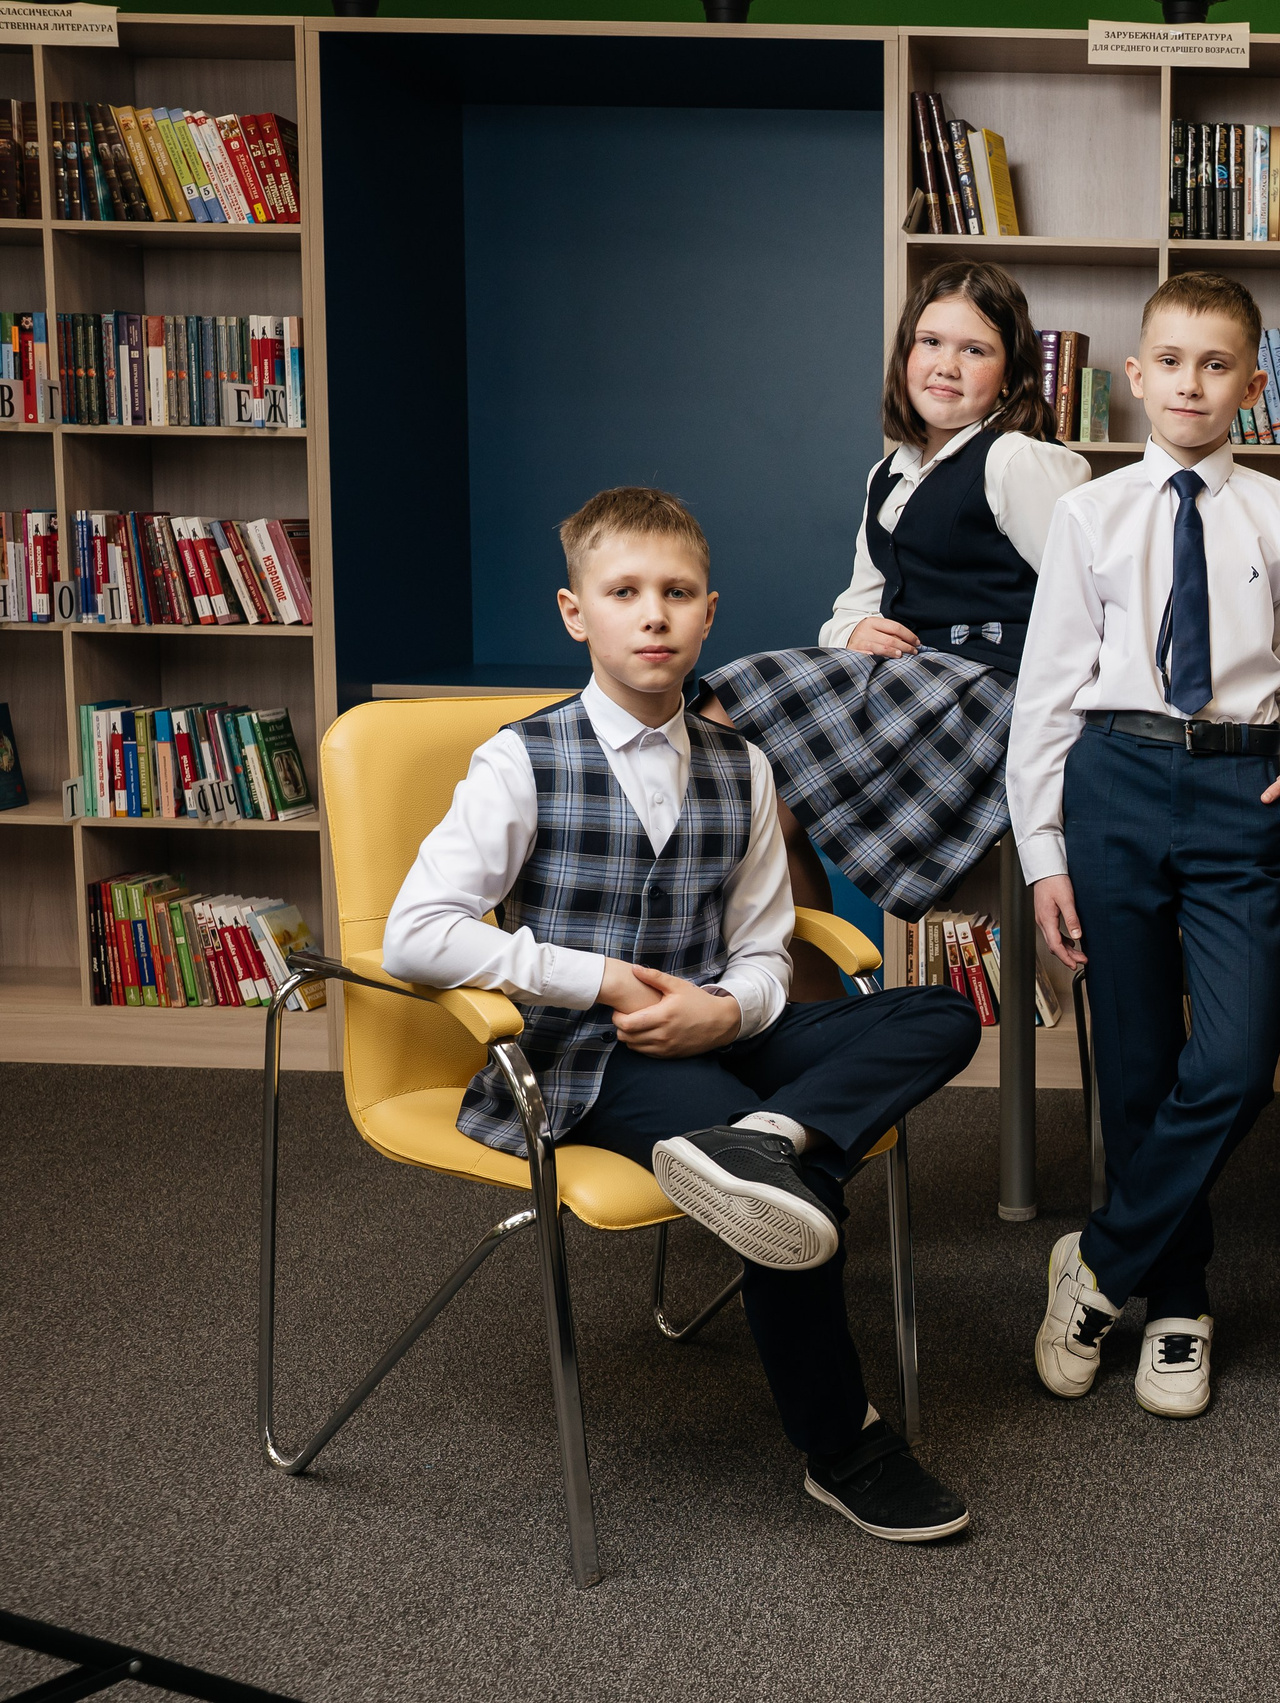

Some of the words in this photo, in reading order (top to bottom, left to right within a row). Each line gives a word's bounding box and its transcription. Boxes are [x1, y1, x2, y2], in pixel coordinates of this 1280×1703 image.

[51, 23, 113, 32] ЛИТЕРАТУРА
[1104, 31, 1168, 40] ЗАРУБЕЖНАЯ
[1170, 32, 1233, 41] ЛИТЕРАТУРА
[1092, 44, 1109, 52] ДЛЯ
[1111, 44, 1151, 52] СРЕДНЕГО
[1205, 46, 1245, 54] ВОЗРАСТА
[186, 186, 195, 196] 5
[203, 186, 210, 196] 5
[239, 153, 259, 199] ХРЕСТОМАТИЯ
[0, 384, 14, 418] В
[48, 386, 59, 420] Г
[234, 388, 252, 423] Е
[264, 388, 285, 423] Ж
[94, 539, 103, 576] Островский
[183, 549, 196, 578] Пушкин
[198, 549, 211, 578] Пушкин
[262, 555, 287, 603] ИЗБРАННОЕ
[58, 586, 74, 618] О
[107, 587, 122, 620] П
[113, 748, 121, 781] Тургенев
[181, 755, 191, 783] Толстой
[66, 783, 80, 818] Т
[223, 784, 240, 815] Ч
